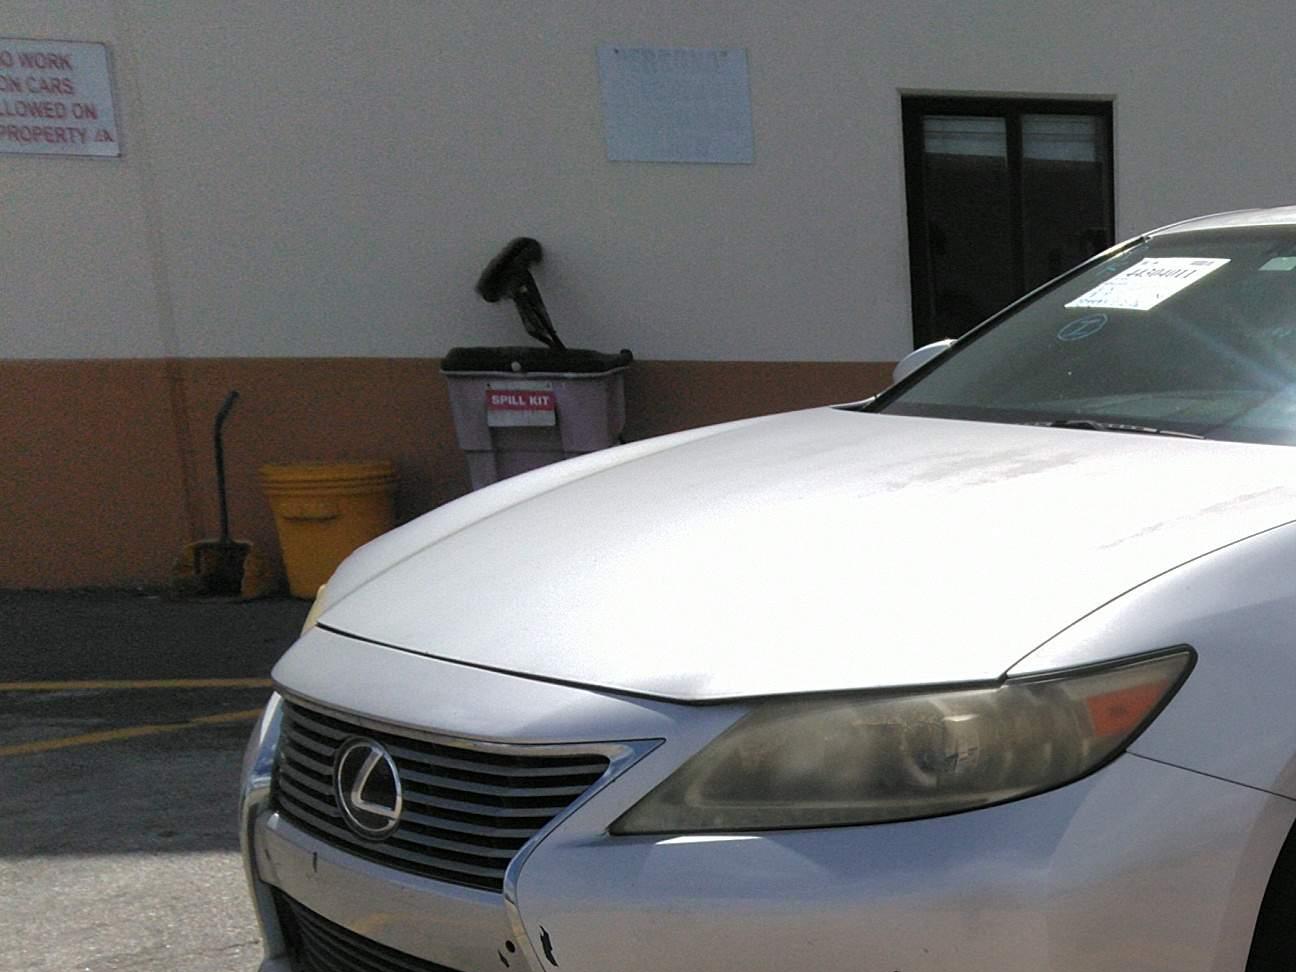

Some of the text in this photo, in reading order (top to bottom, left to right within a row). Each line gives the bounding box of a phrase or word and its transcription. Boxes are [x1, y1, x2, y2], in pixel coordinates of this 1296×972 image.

[18, 52, 73, 71] WORK
[25, 76, 75, 95] CARS
[71, 102, 98, 120] ON
[491, 395, 550, 406] SPILL KIT
